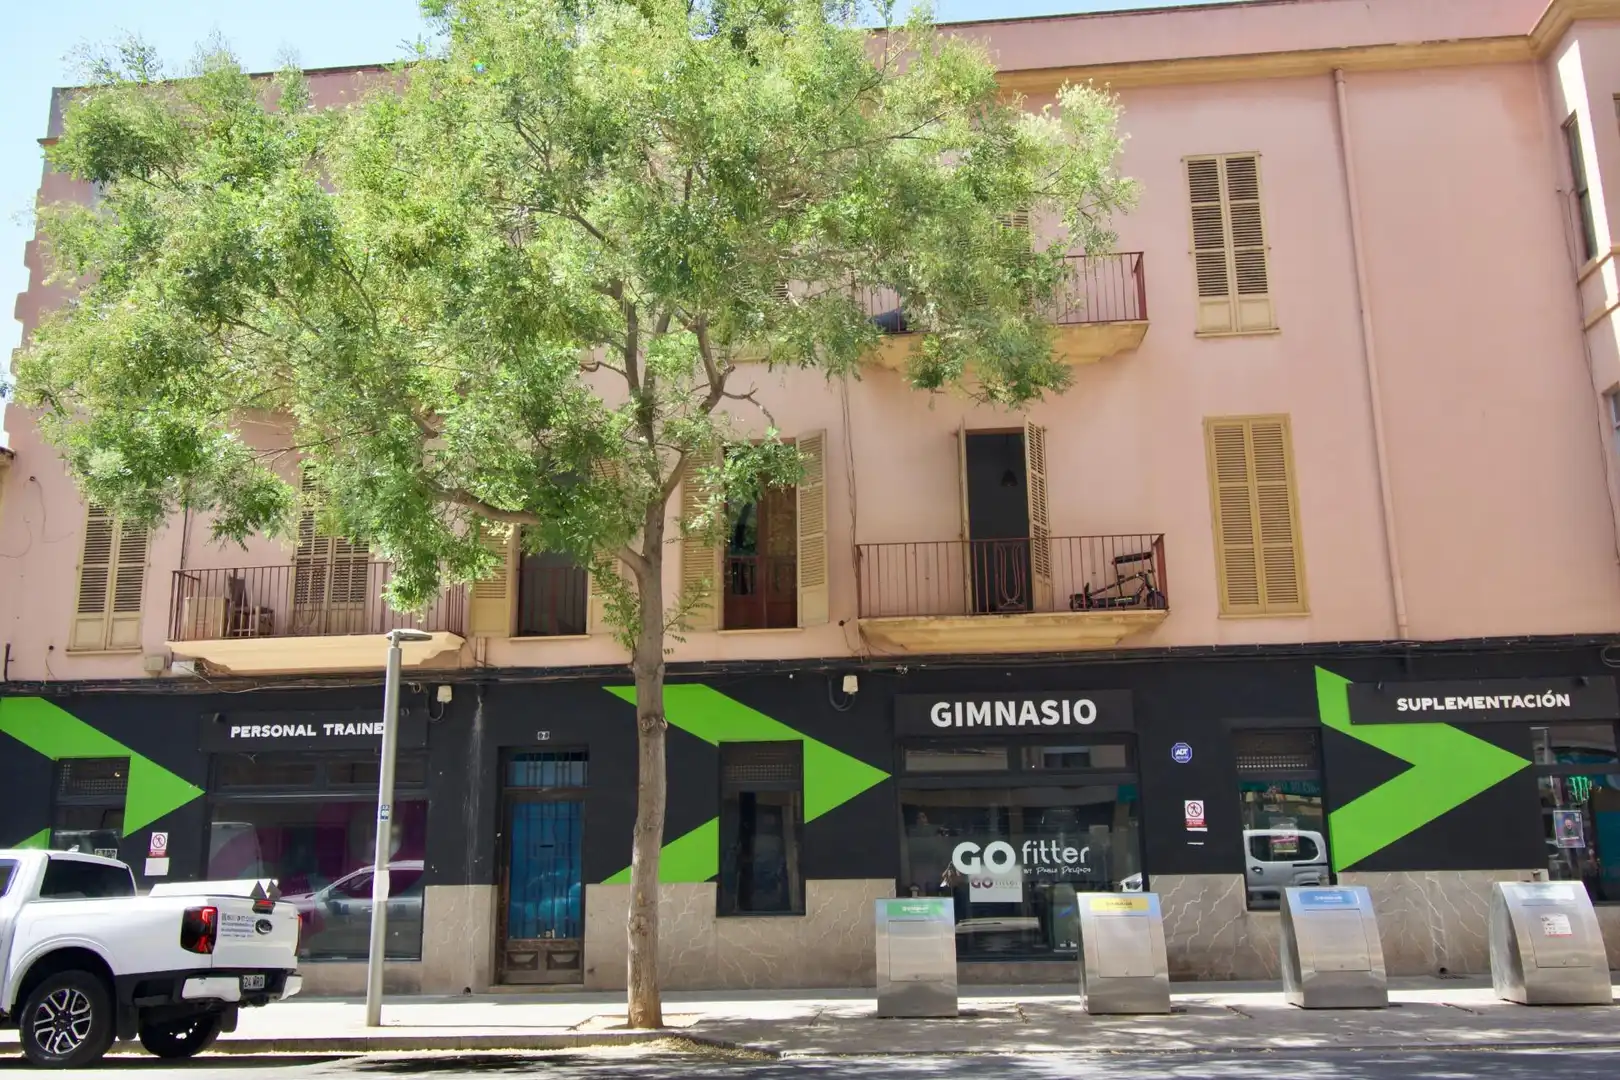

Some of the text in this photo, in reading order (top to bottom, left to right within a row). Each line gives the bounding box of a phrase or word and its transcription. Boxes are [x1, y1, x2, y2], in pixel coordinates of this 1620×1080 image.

[930, 699, 1097, 728] GIMNASIO
[1396, 690, 1571, 712] SUPLEMENTACIÓN
[230, 722, 385, 738] PERSONAL TRAINE
[952, 839, 1090, 875] GO fitter
